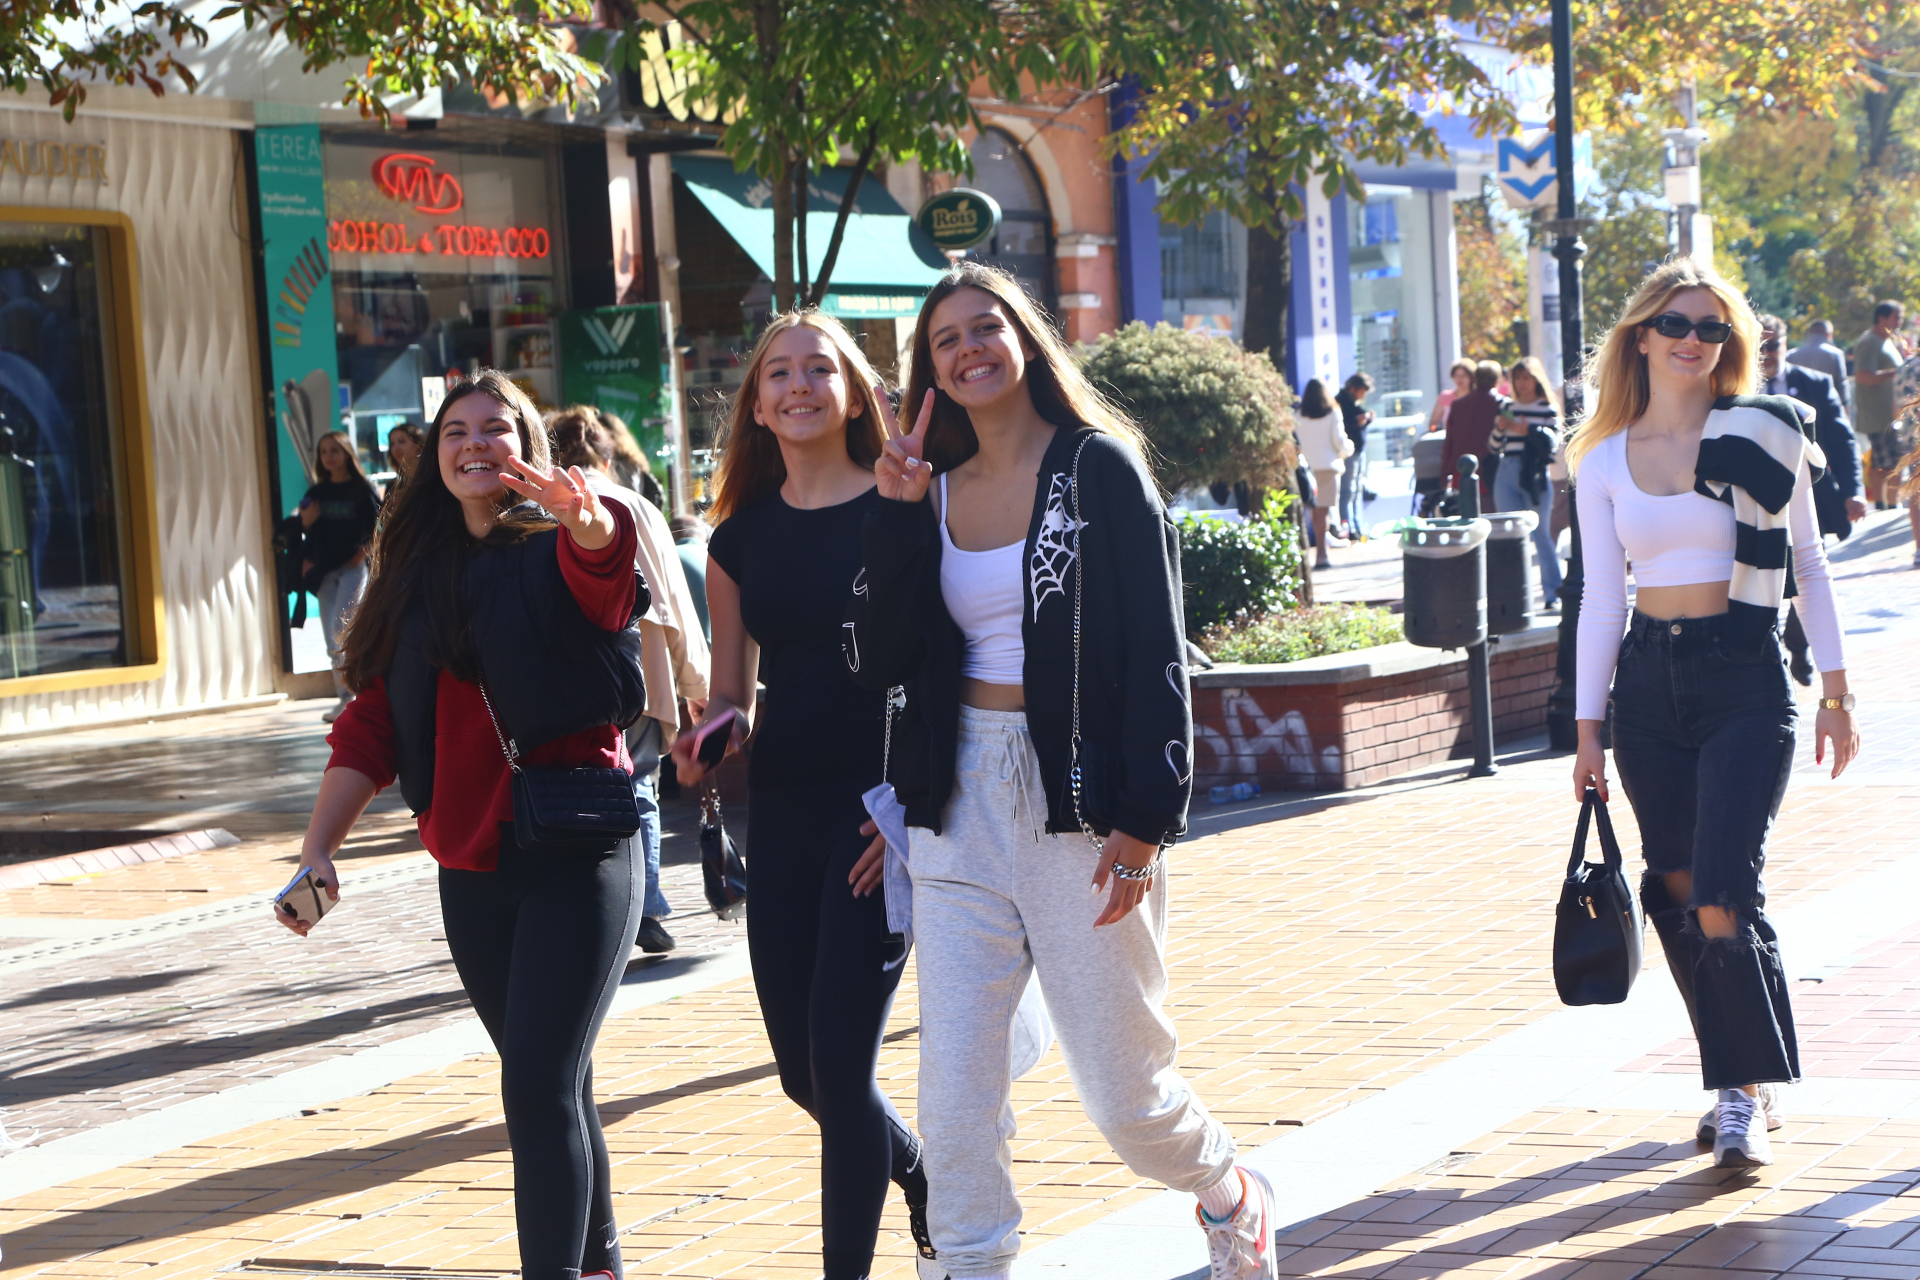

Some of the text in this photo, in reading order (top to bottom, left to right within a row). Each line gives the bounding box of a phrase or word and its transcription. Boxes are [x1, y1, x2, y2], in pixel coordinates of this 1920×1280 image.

[0, 139, 108, 180] AUDER
[258, 133, 321, 161] TEREA
[935, 208, 976, 229] Rois
[437, 225, 550, 258] TOBACCO
[583, 357, 640, 374] vapepro
